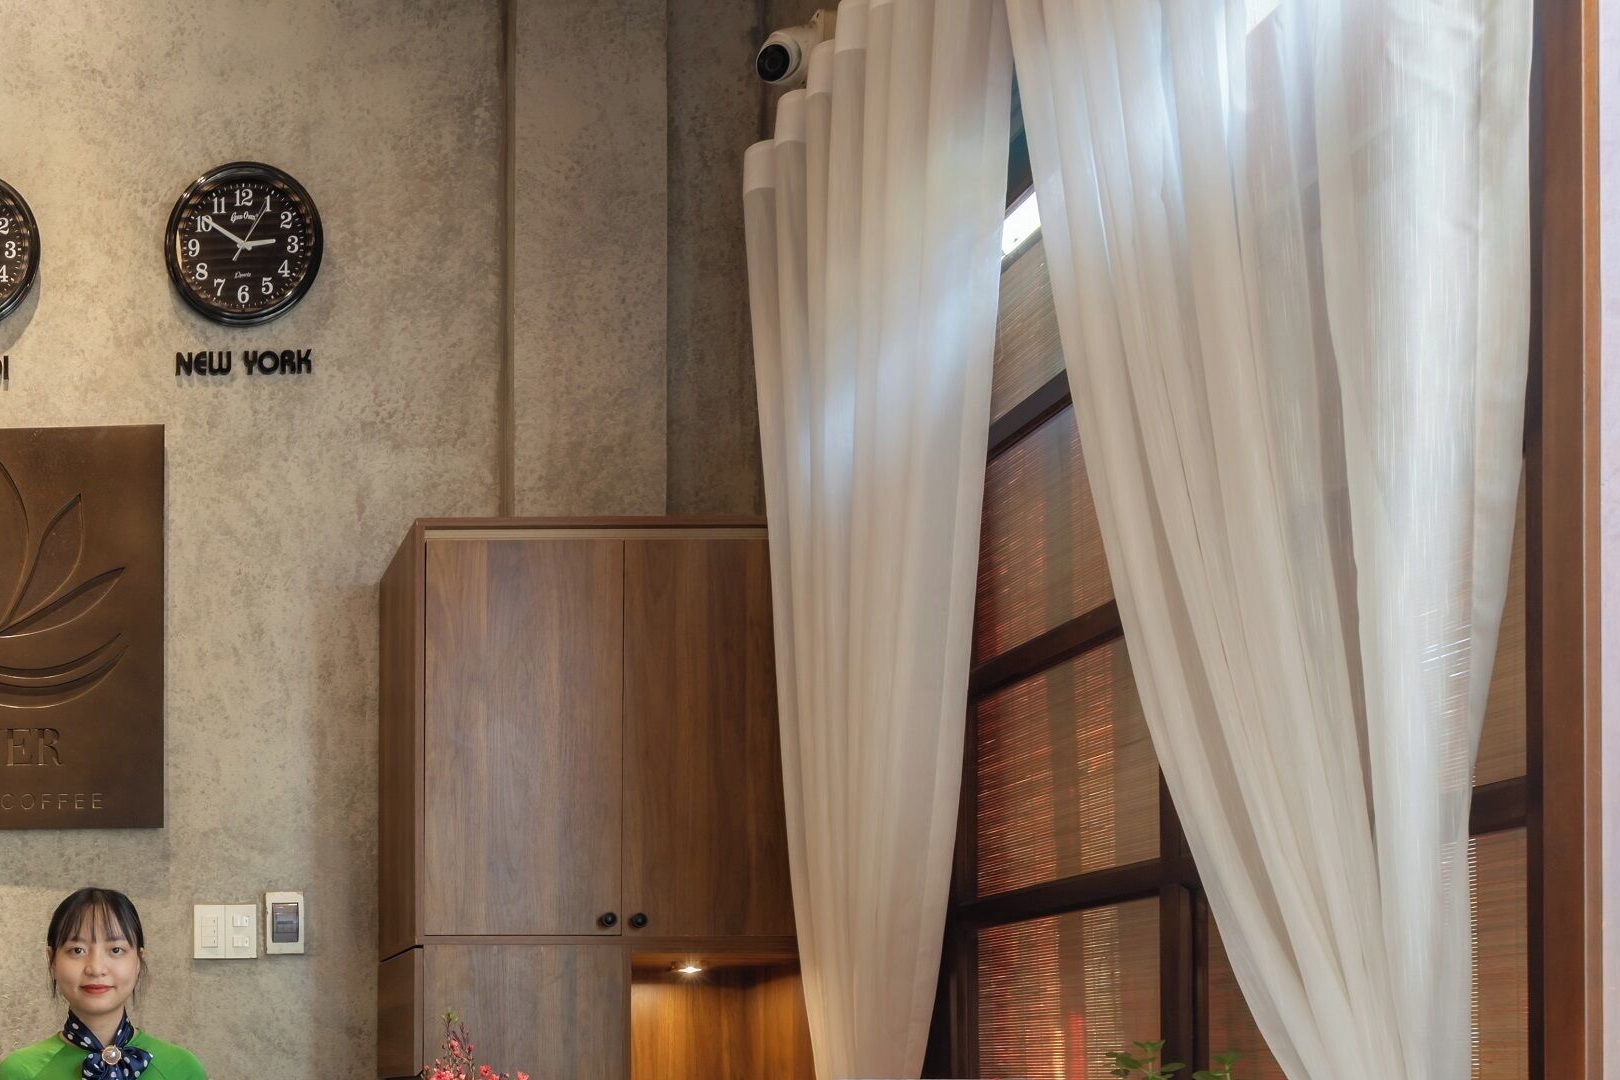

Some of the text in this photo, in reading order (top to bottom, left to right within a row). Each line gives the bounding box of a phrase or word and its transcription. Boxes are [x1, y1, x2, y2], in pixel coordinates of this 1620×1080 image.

[213, 197, 227, 213] 11
[235, 189, 253, 206] 12
[264, 196, 272, 212] 1
[195, 216, 212, 232] 10
[281, 212, 292, 229] 2
[5, 242, 16, 258] 3
[188, 239, 200, 257] 9
[287, 236, 298, 253] 3
[196, 263, 208, 280] 8
[278, 260, 290, 277] 4
[214, 279, 225, 296] 7
[238, 285, 249, 303] 6
[261, 277, 273, 294] 5
[175, 349, 312, 376] NEW YORK
